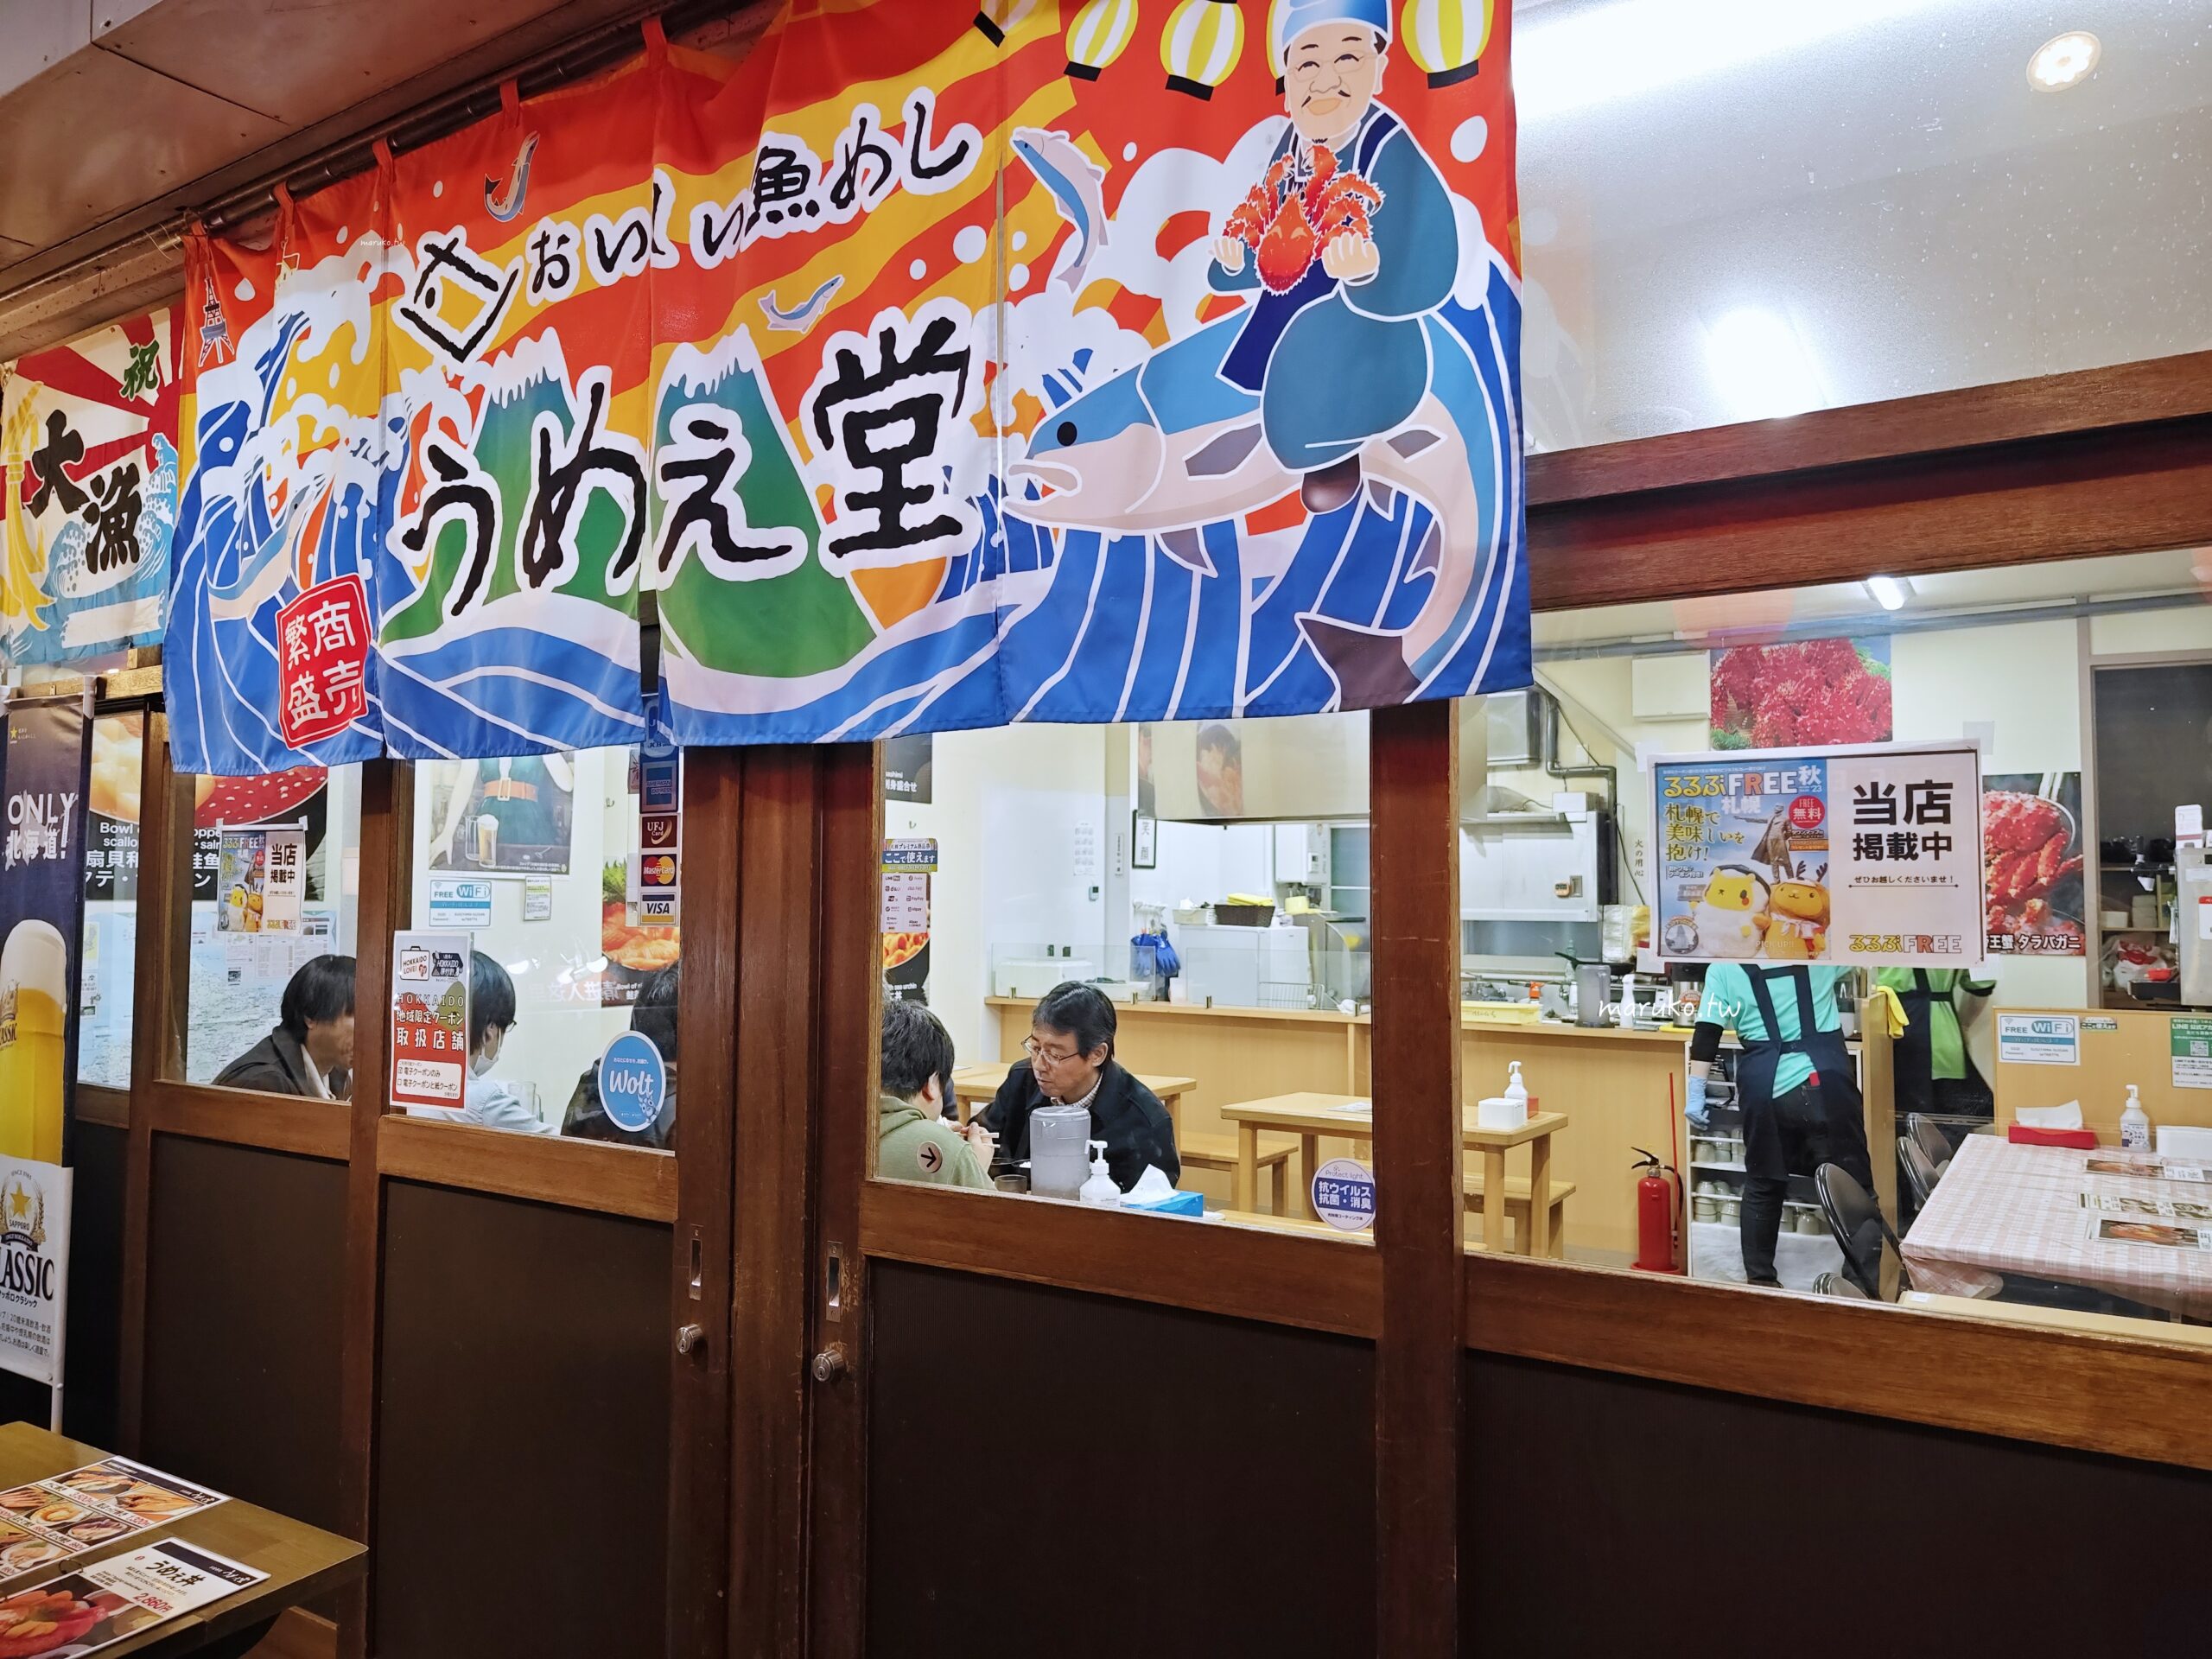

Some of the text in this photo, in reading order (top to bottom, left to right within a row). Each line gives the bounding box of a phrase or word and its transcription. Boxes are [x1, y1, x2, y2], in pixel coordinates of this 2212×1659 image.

[531, 100, 969, 294] おいしい魚めし
[120, 339, 160, 401] 祝
[401, 316, 973, 618] うめえ堂
[25, 409, 143, 575] 大漁
[307, 600, 363, 716] 商売
[284, 613, 329, 732] 繁盛
[1798, 765, 1822, 786] 秋
[1799, 798, 1815, 808] FREE
[1853, 779, 1954, 826] 当店
[1665, 802, 1721, 825] 札幌で
[1793, 807, 1821, 820] 無料
[99, 822, 133, 834] Bowl
[647, 822, 664, 832] UFJ
[1665, 823, 1745, 844] 美味しいを
[1852, 830, 1953, 861] 掲載中
[270, 843, 298, 867] 当店
[884, 851, 936, 864] ここで使えます
[1634, 838, 1644, 877] 火の用心
[270, 868, 296, 884] 掲載中
[643, 866, 676, 875] MasterCard
[434, 890, 454, 899] FREE
[646, 903, 670, 915] VISA
[1986, 934, 2082, 950] 王蟹 タラバガニ
[403, 955, 428, 967] HOKKAIDO
[396, 994, 465, 1007] HOKKAIDO
[396, 1009, 465, 1026] 地域限定クーポン
[2004, 1026, 2028, 1034] FREE
[396, 1027, 465, 1052] 取扱店舗
[609, 1069, 654, 1096] Wolt
[1325, 1169, 1349, 1179] Protect
[1318, 1180, 1371, 1198] 抗ウイルス
[1319, 1193, 1372, 1211] 抗菌・消臭
[9, 1218, 30, 1231] SAPPORO
[0, 1244, 54, 1302] ASSIC
[132, 1592, 174, 1613] 2,860円
